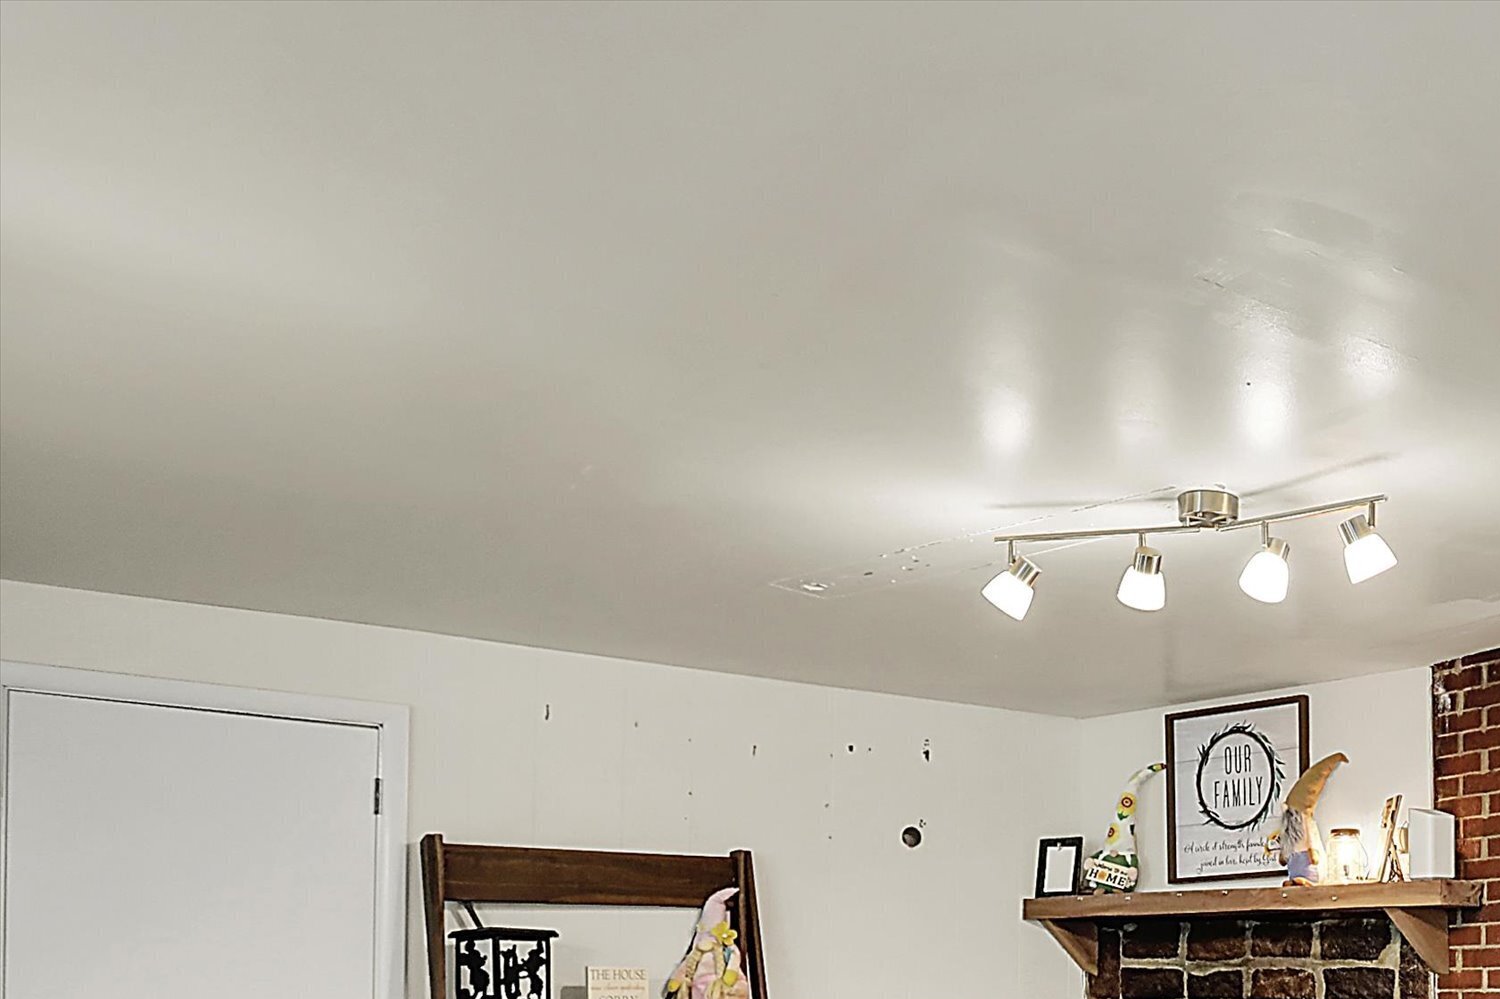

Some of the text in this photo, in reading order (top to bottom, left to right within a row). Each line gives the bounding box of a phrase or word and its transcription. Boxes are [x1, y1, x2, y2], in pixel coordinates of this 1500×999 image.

[1225, 744, 1251, 774] OUR
[1214, 776, 1262, 809] FAMILY
[591, 968, 647, 980] THE HOUSE
